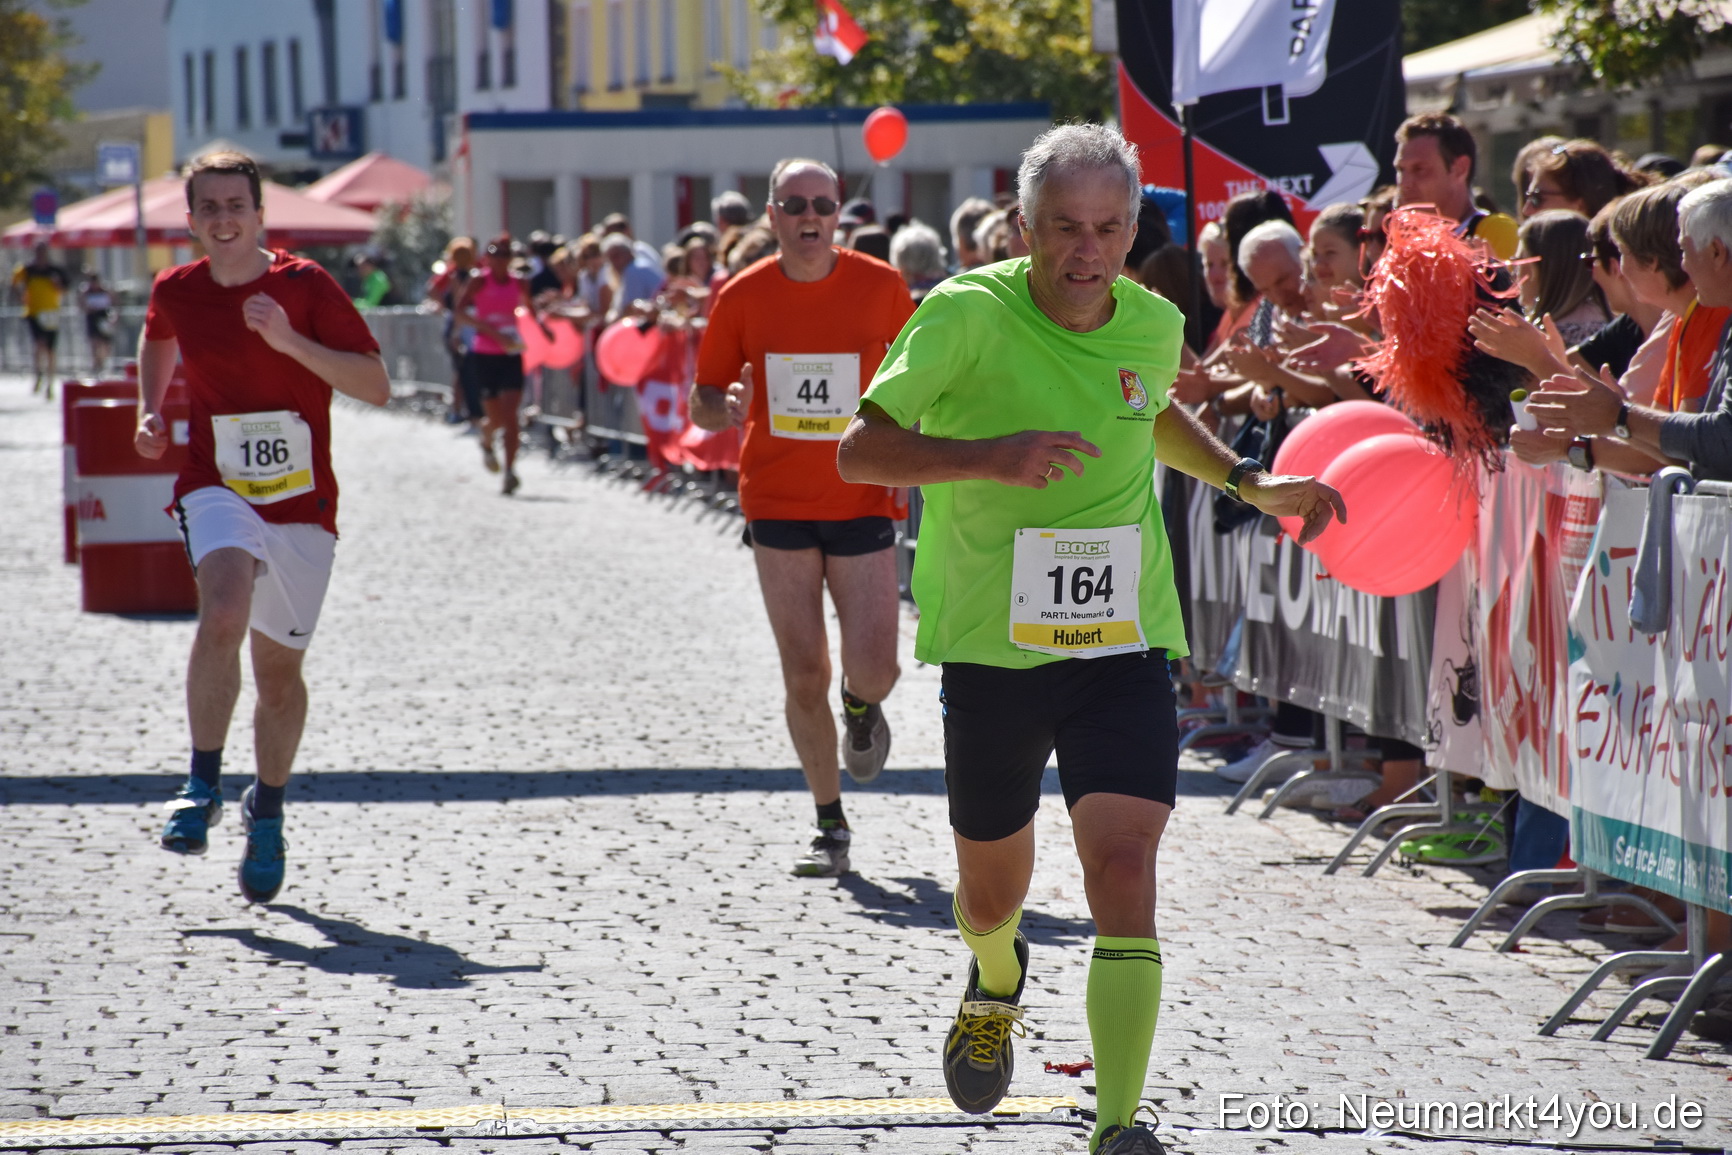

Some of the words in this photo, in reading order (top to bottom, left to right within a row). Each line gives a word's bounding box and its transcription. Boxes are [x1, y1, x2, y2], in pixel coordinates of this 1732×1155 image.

[1224, 180, 1259, 198] THE
[1265, 174, 1314, 195] NEXT
[793, 363, 833, 372] BOCK
[797, 379, 829, 404] 44
[797, 420, 830, 432] Alfred
[240, 438, 289, 467] 186
[248, 478, 288, 496] Samuel
[1055, 540, 1110, 555] BOCK
[1047, 565, 1114, 605] 164
[1018, 595, 1024, 603] B
[1041, 611, 1069, 619] PARTL
[1071, 610, 1105, 619] Neumarkt
[1053, 628, 1103, 646] Hubert
